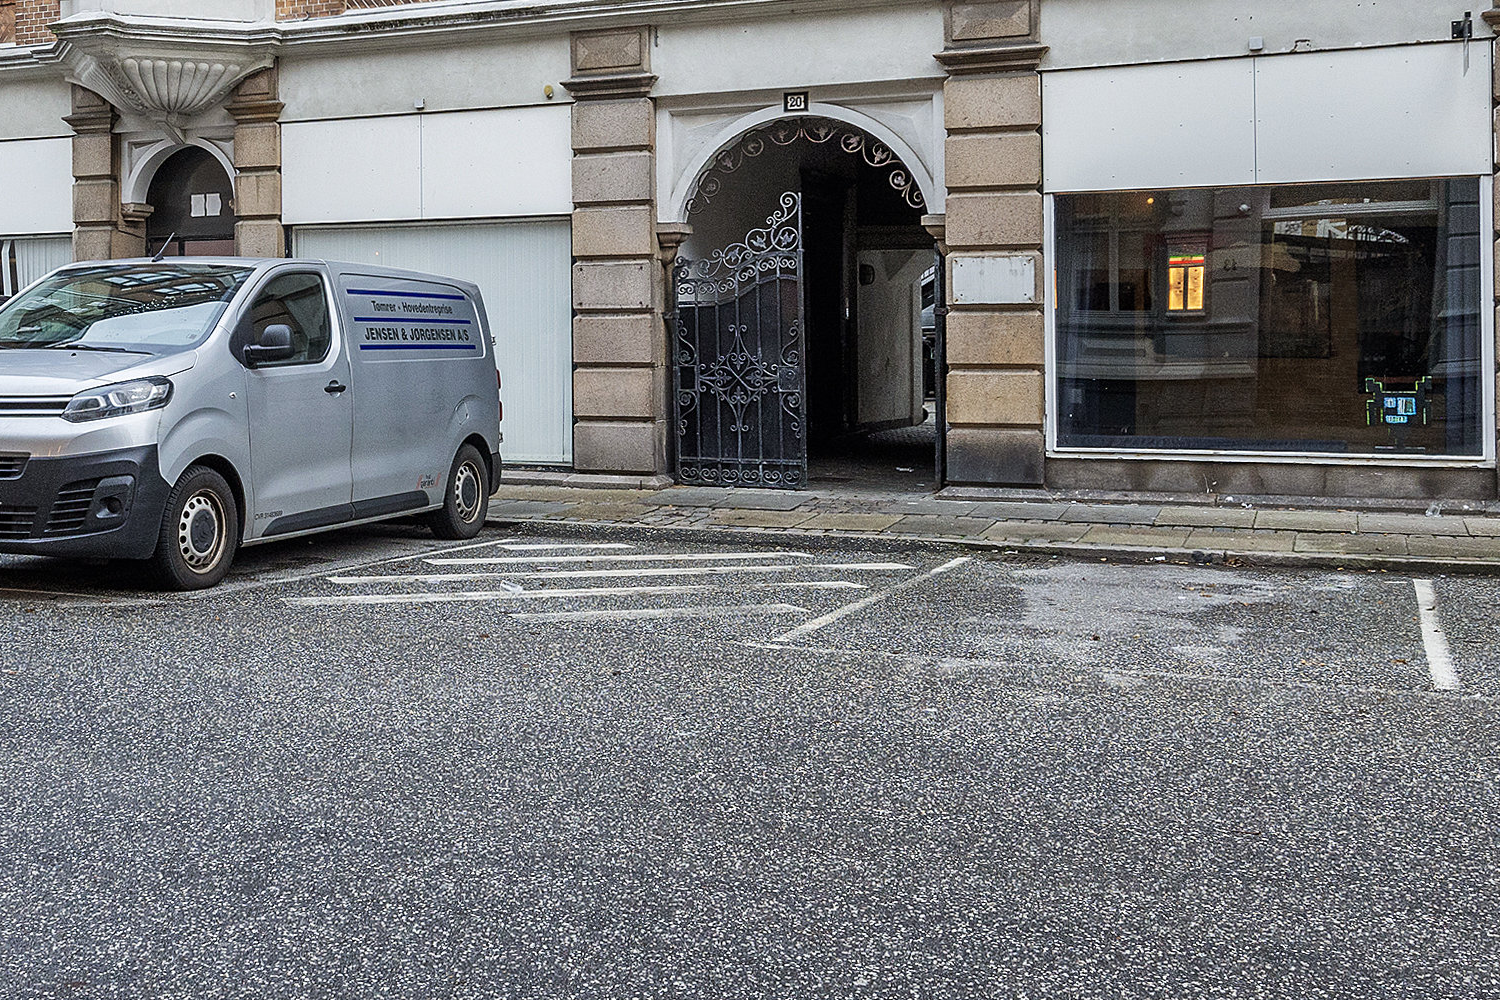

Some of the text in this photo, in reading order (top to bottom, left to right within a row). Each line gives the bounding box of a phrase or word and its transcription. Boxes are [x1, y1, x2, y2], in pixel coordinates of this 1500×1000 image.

[789, 96, 802, 108] 20
[402, 302, 453, 316] Hovedentreprise
[365, 327, 400, 341] JENSEN
[401, 328, 408, 341] &
[409, 328, 457, 341] JØRGENSEN
